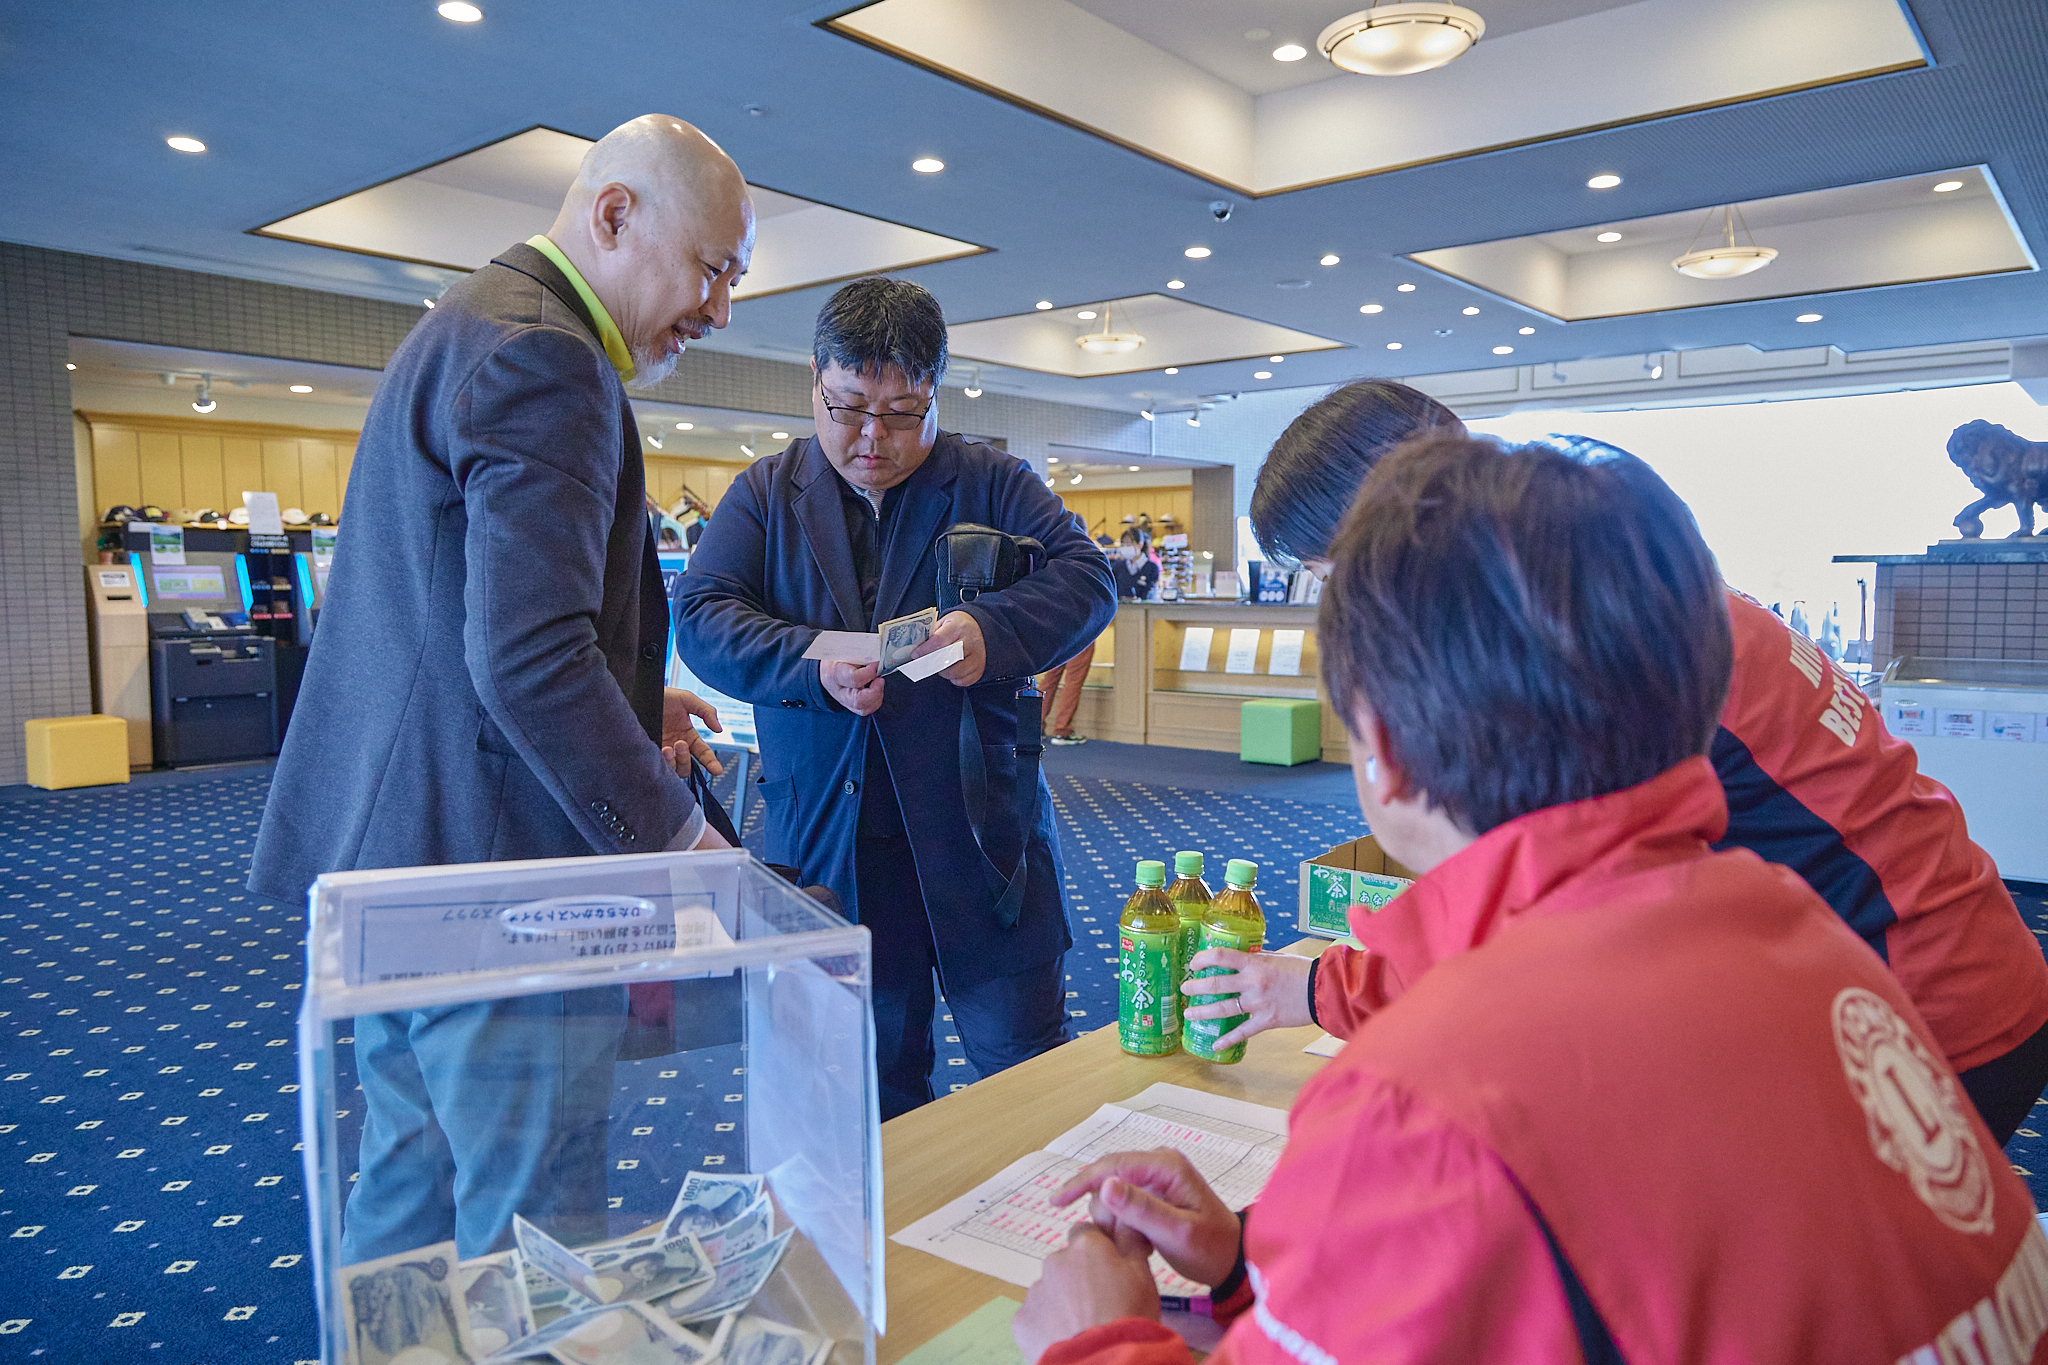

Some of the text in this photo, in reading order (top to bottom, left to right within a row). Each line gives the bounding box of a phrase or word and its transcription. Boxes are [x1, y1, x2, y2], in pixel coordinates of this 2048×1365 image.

[1818, 674, 1866, 748] BEST
[681, 1177, 701, 1201] 1000
[664, 1236, 690, 1252] 1000
